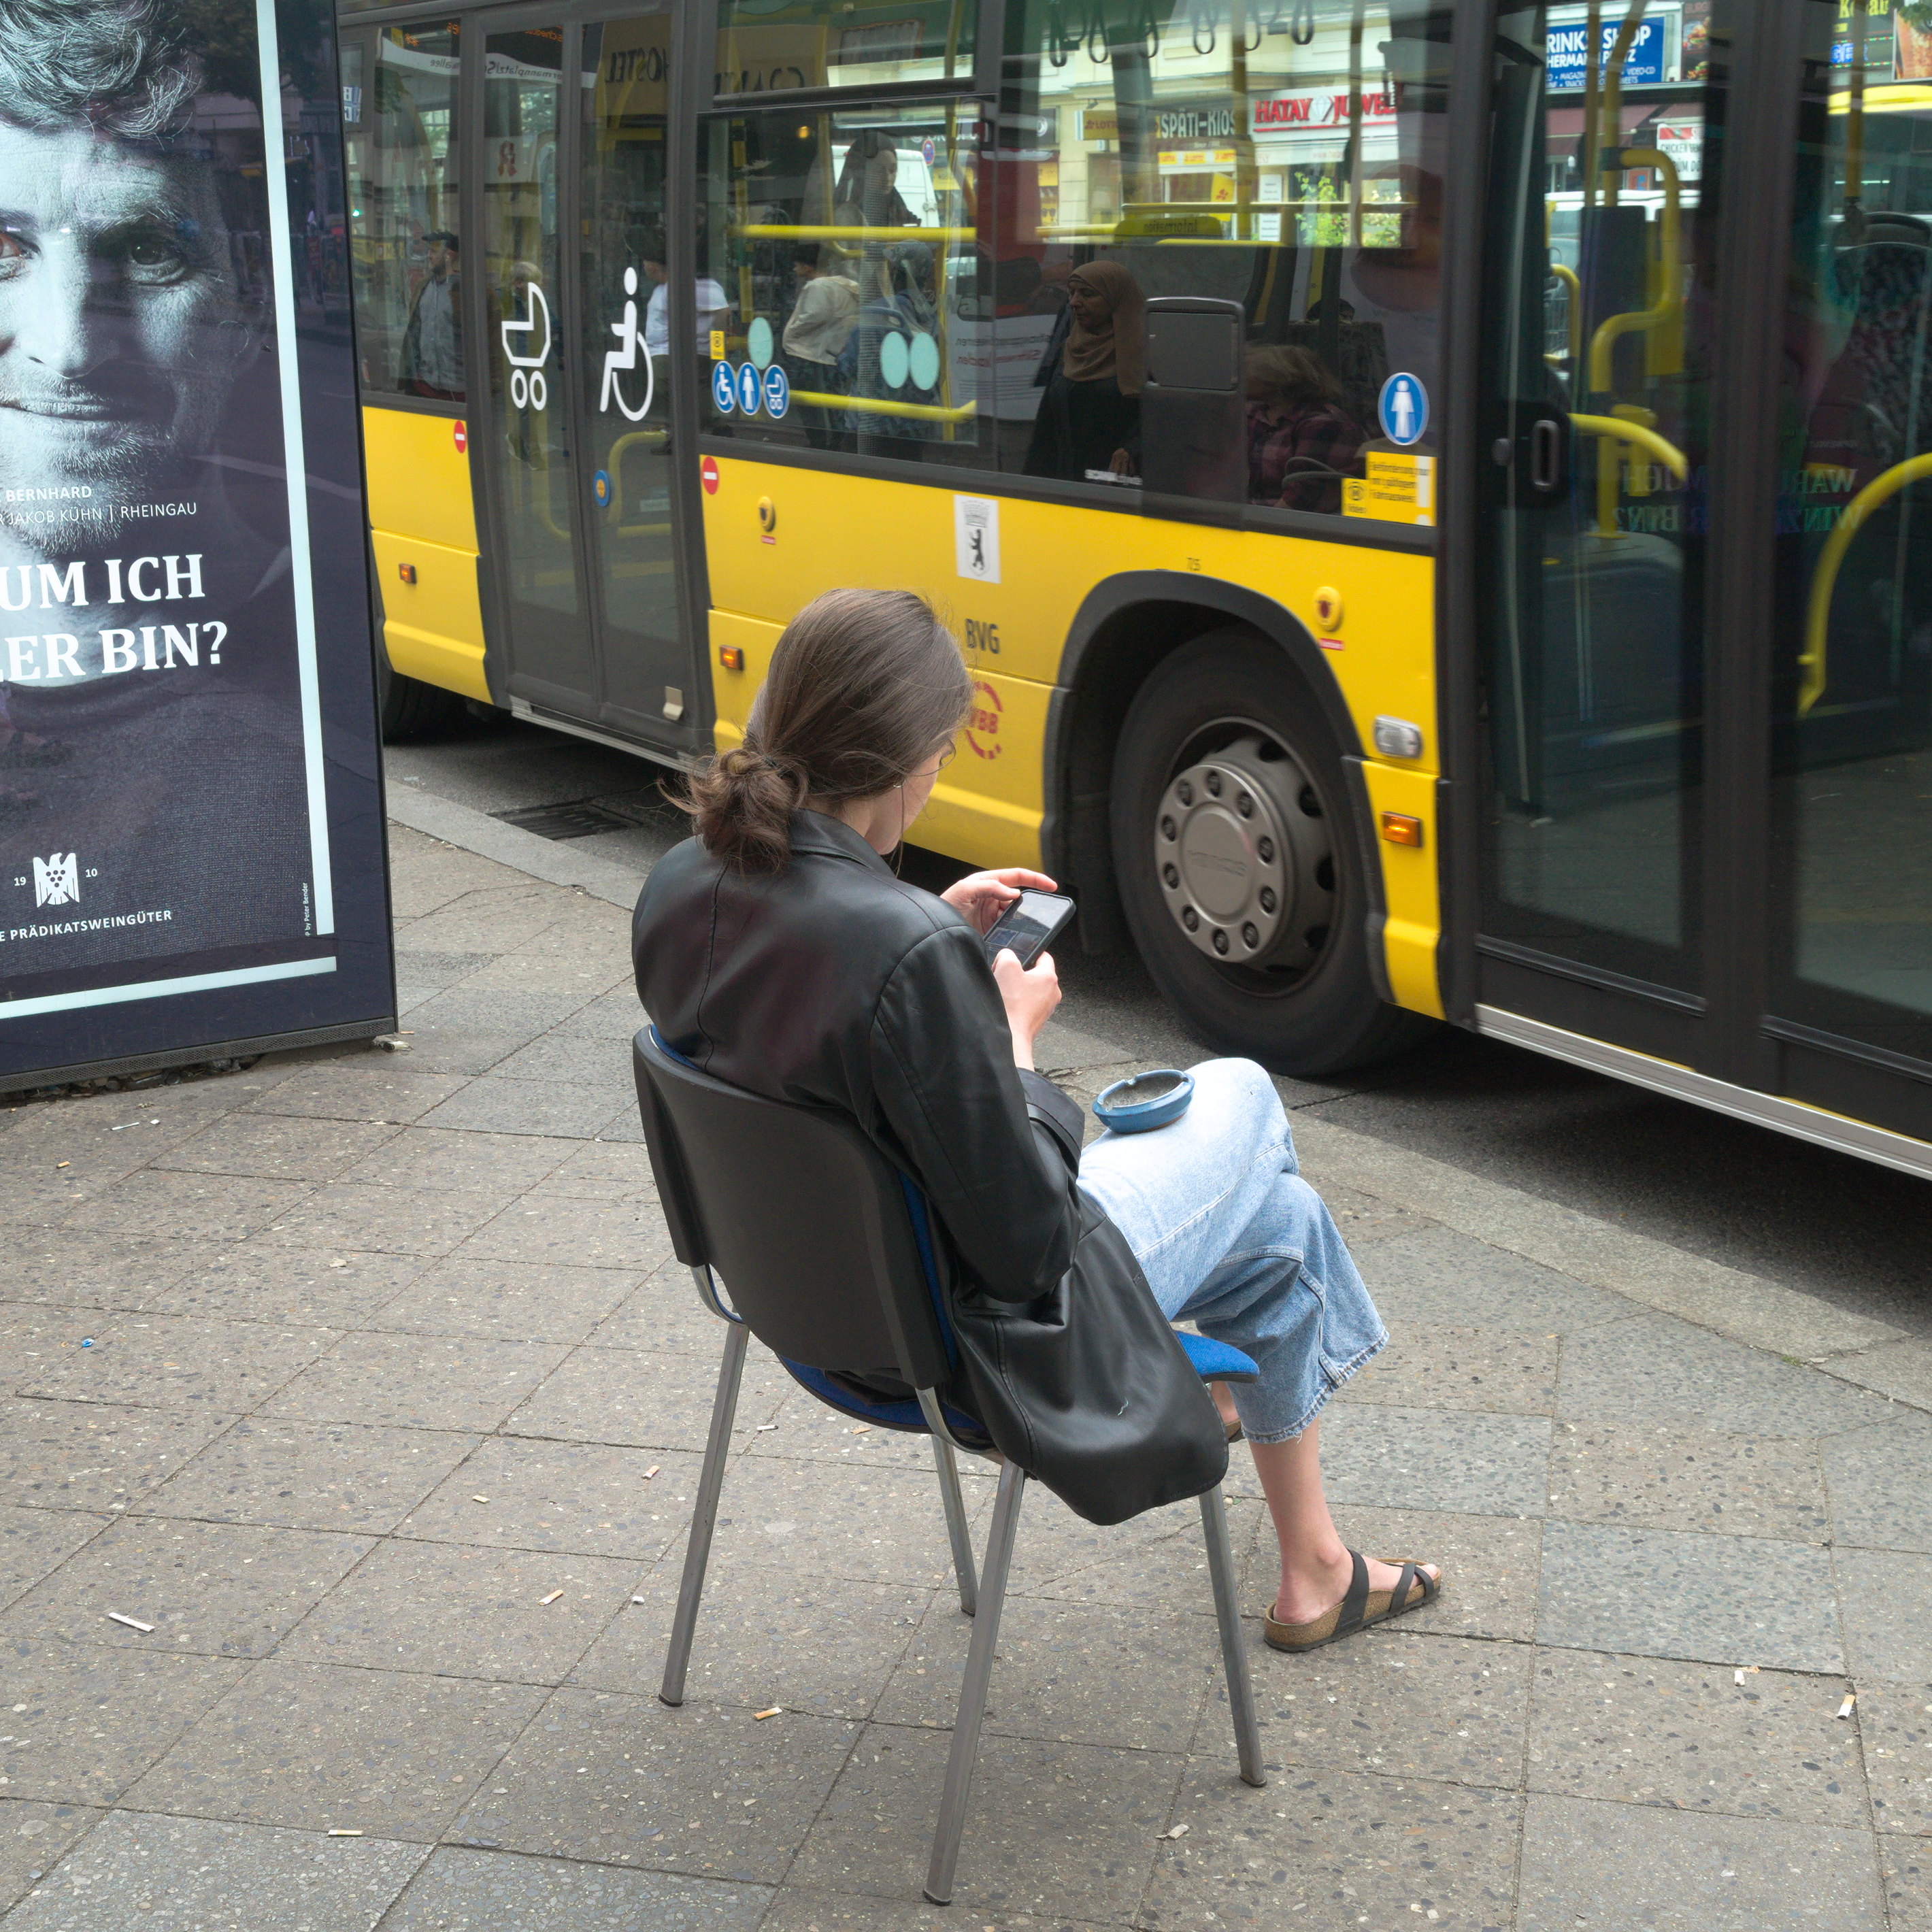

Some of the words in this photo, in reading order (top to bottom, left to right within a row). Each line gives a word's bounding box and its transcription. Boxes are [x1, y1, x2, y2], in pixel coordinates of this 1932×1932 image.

[1546, 31, 1588, 54] RINK
[1547, 52, 1601, 69] HERMA
[1254, 97, 1314, 124] HATAY
[6, 485, 93, 503] BERNHARD
[10, 511, 56, 525] JAKOB
[61, 506, 103, 522] KÜHN
[120, 502, 197, 519] RHEINGAU
[0, 561, 89, 612] UM
[104, 554, 205, 604] ICH
[965, 618, 1001, 654] BVG
[0, 633, 86, 682] ER
[98, 620, 228, 674] BIN?
[14, 876, 27, 886] 19
[85, 868, 98, 878] 10
[10, 910, 172, 941] PRÄDIKATSWEINGÜTER
[304, 922, 312, 931] by
